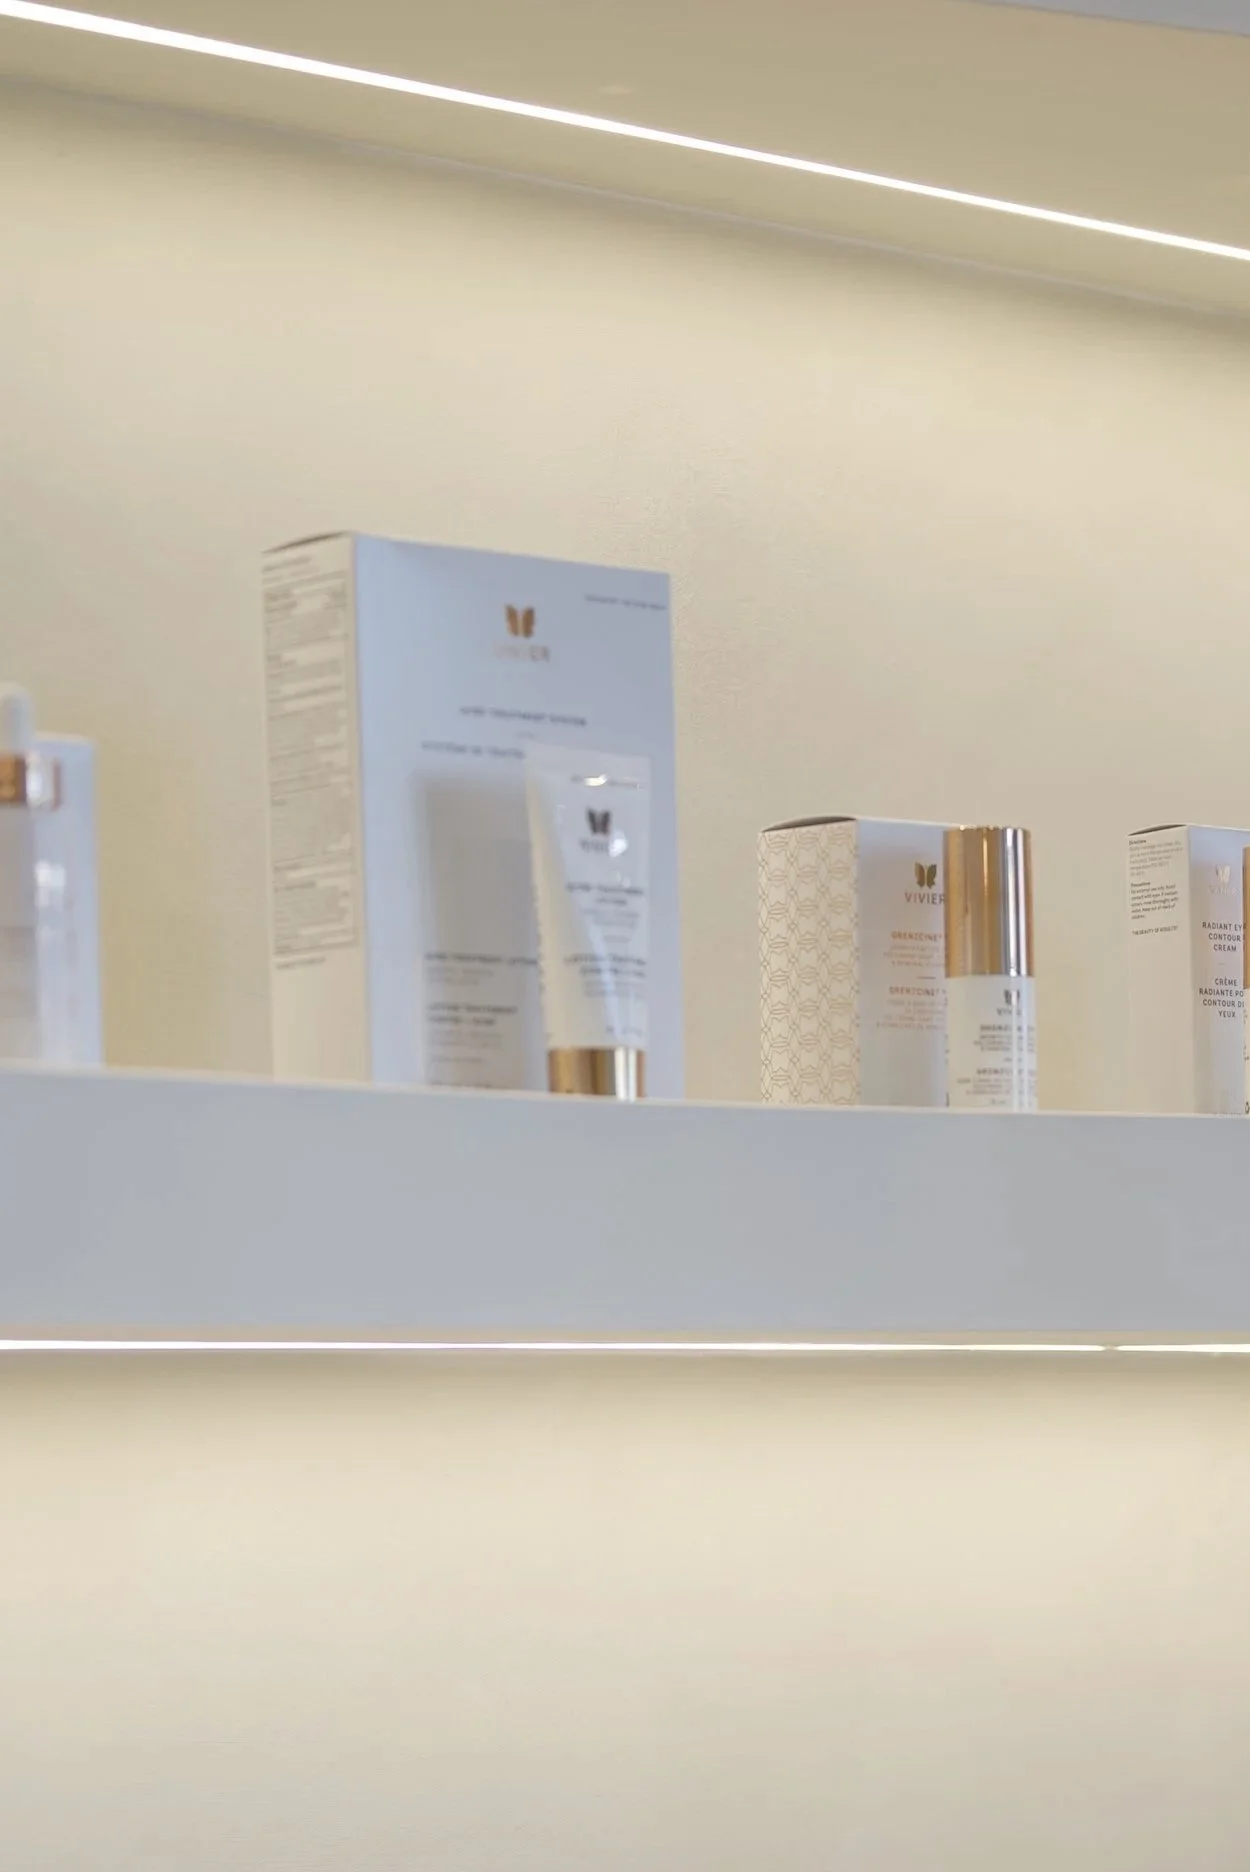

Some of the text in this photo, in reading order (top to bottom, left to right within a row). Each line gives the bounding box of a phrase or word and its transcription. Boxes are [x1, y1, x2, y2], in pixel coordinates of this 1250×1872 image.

[1201, 921, 1243, 933] RADIANT EY
[1208, 933, 1241, 943] CONTOUR
[1213, 944, 1237, 952] CREAM
[1214, 976, 1238, 987] CRÈME
[1199, 988, 1244, 999] RADIANTE PO
[1202, 999, 1236, 1009] CONTOUR
[1218, 1010, 1236, 1019] YEUX
